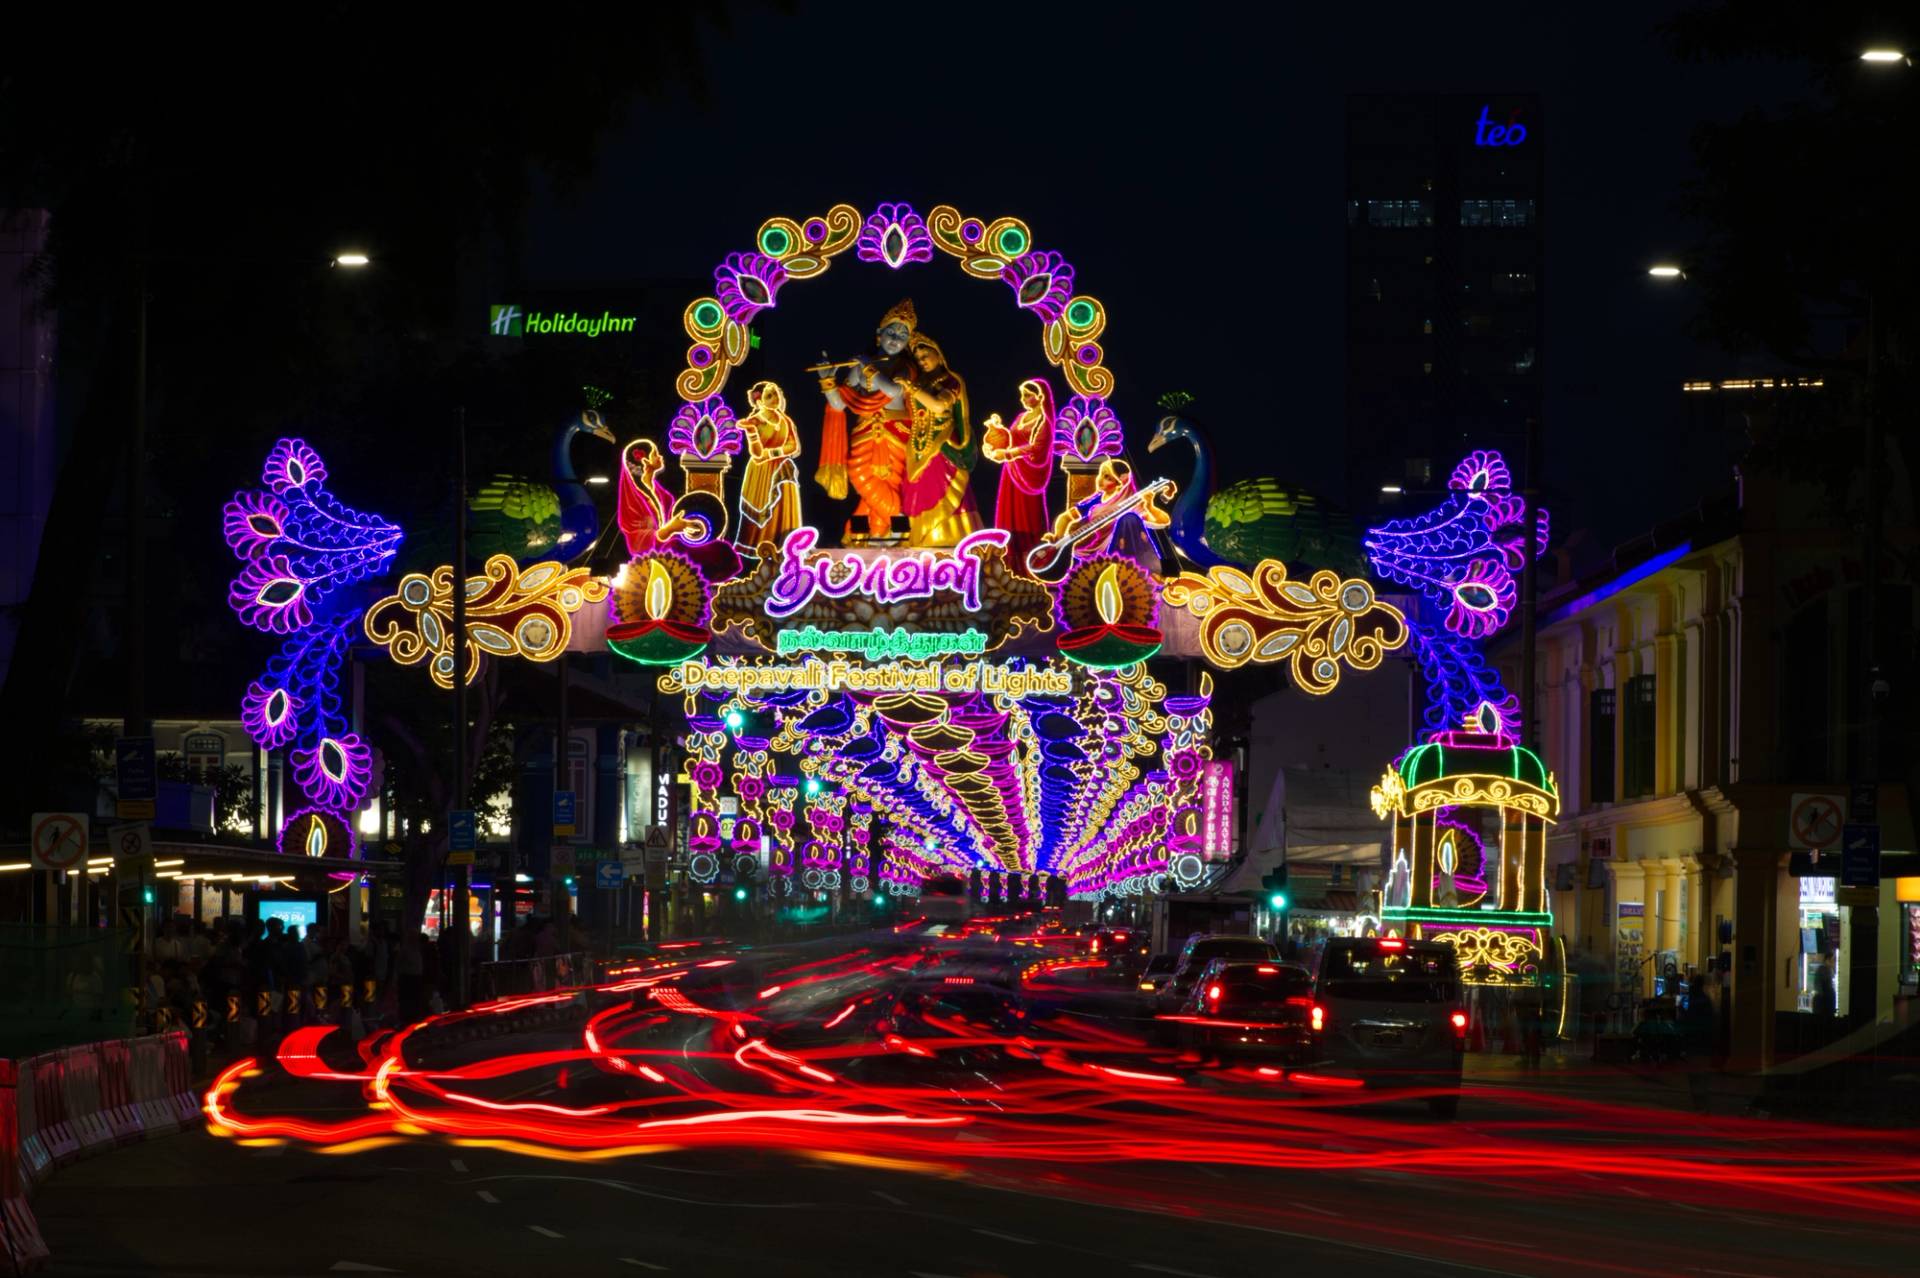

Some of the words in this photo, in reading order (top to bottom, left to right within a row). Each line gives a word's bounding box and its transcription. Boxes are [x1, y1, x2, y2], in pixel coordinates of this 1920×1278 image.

[765, 527, 1011, 618] தீபாவளி
[683, 661, 824, 695] Deepavali
[829, 663, 940, 690] Festival
[945, 663, 977, 691] of
[984, 664, 1071, 698] Lights
[1221, 776, 1230, 813] ANANDA
[1221, 814, 1230, 852] BHAVAN
